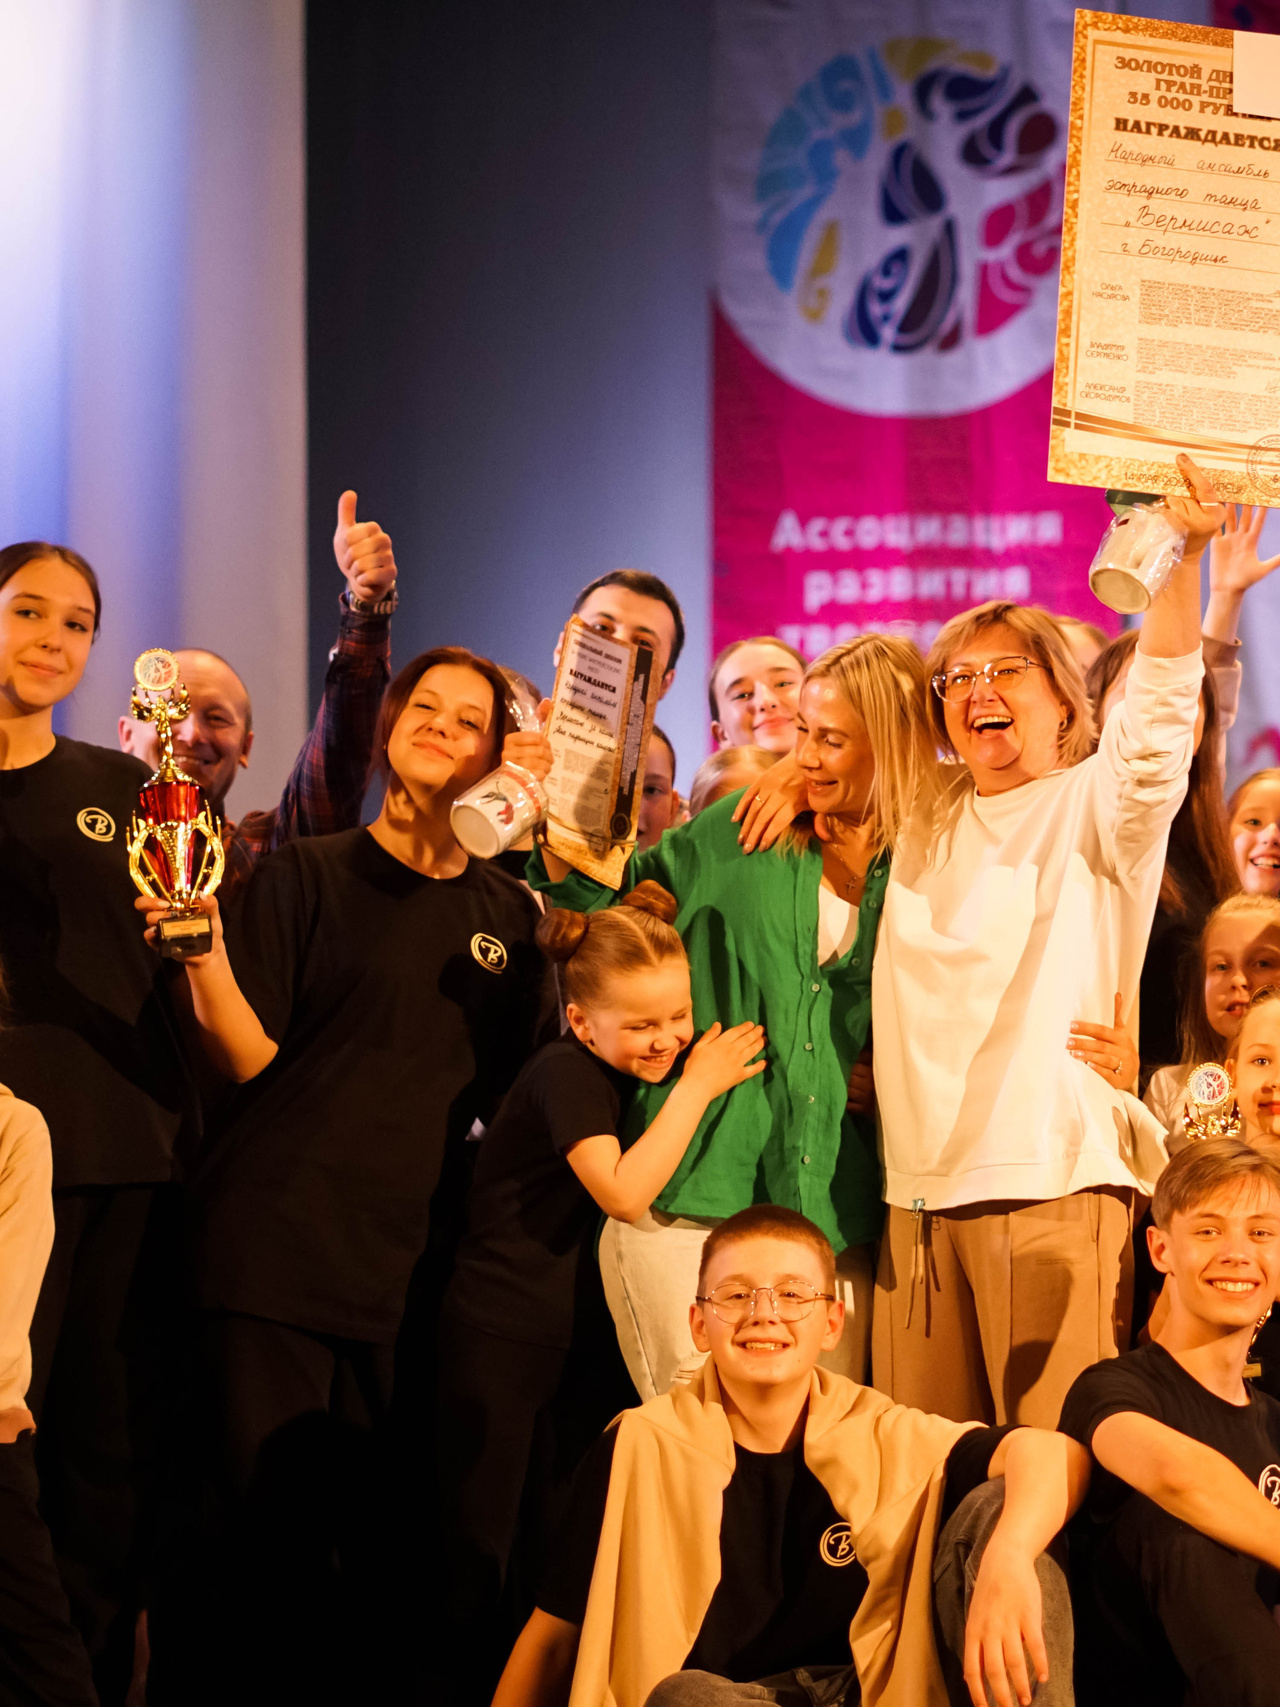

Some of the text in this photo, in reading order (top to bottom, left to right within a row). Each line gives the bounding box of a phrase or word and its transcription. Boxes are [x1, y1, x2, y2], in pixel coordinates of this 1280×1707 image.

[1114, 56, 1202, 80] ЗОЛОТОЙ
[1155, 77, 1233, 100] ГРАН-ПР
[1127, 91, 1150, 106] 35
[1157, 95, 1193, 112] 000
[1107, 140, 1270, 179] Народный ансамбль
[1104, 179, 1262, 212] эстрадного танца
[1120, 242, 1131, 254] г.
[1092, 291, 1130, 302] НАСЫРОВА
[1100, 282, 1123, 291] ОЛЬГА
[1085, 382, 1127, 394] АЛЕКСАНДР
[1124, 472, 1134, 481] 14
[1212, 482, 1244, 495] ИПЕЦК
[770, 508, 1064, 554] Ассоциация
[802, 565, 1031, 615] развития
